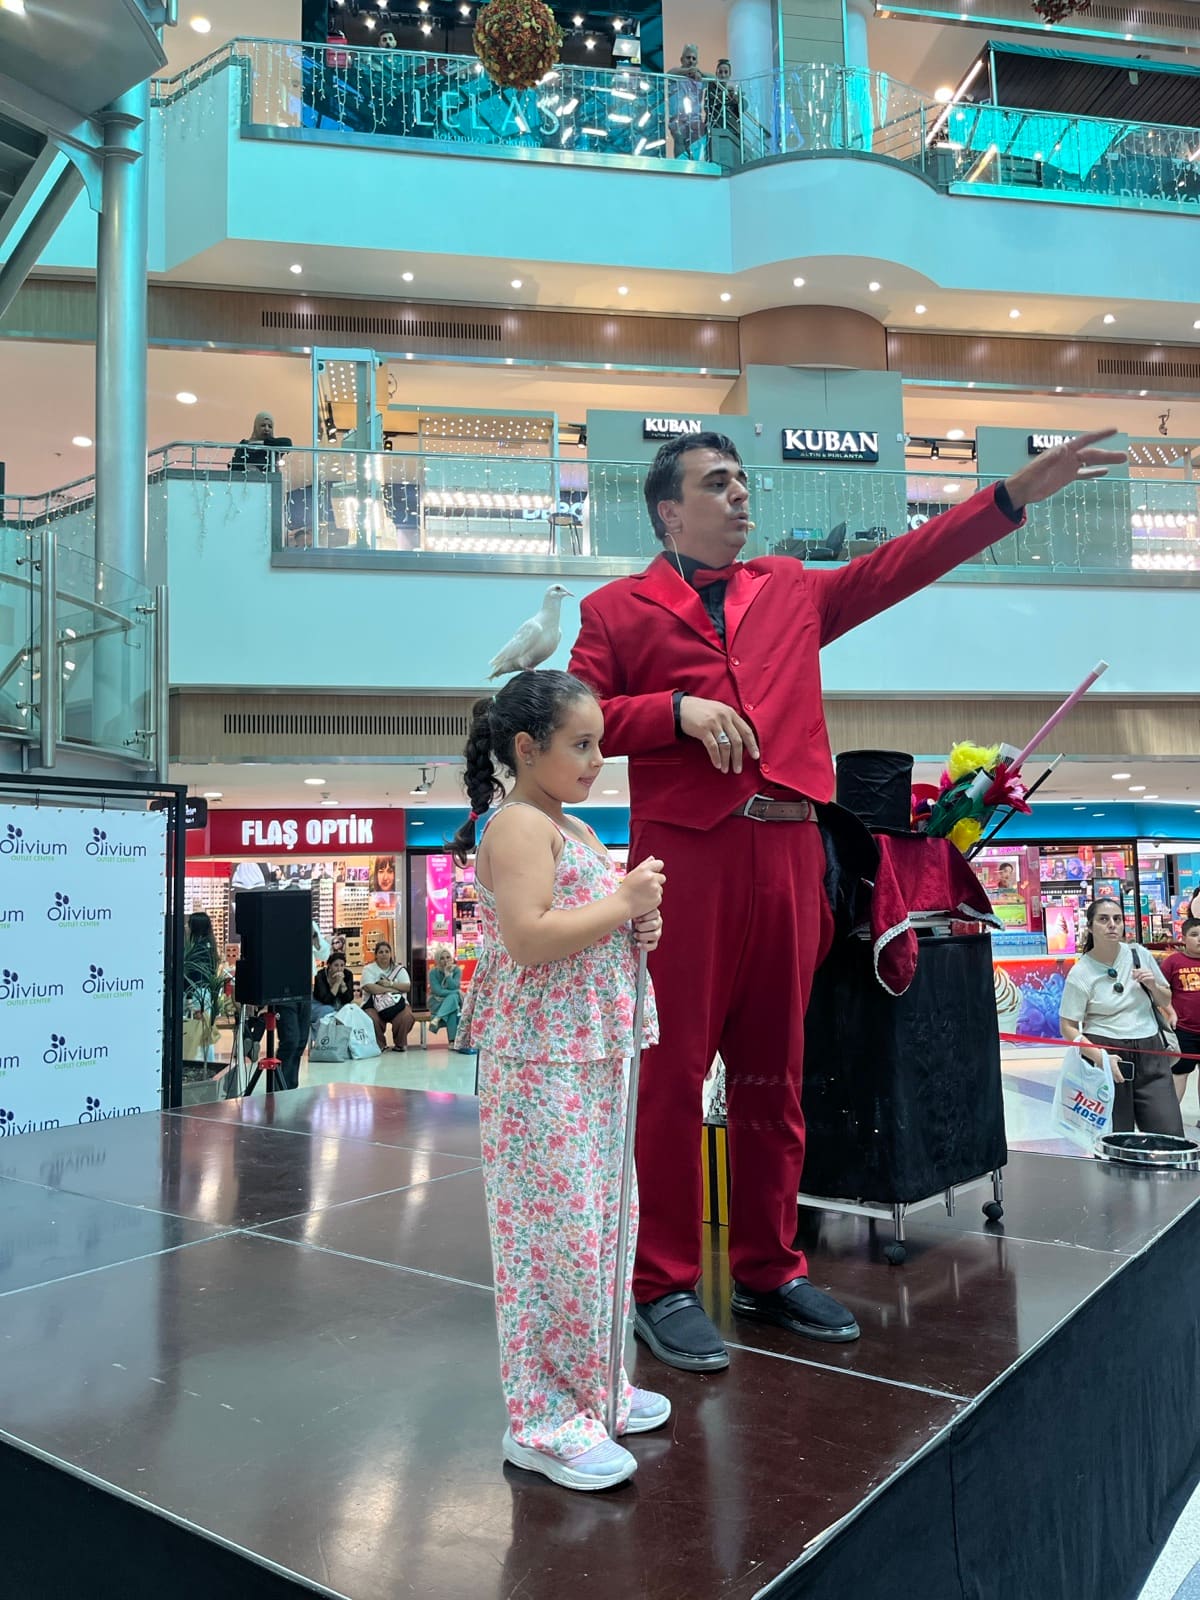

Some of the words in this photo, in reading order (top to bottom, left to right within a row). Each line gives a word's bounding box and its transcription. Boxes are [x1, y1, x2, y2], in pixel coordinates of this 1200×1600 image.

[413, 89, 560, 135] LELAS
[645, 417, 702, 433] KUBAN
[784, 429, 879, 452] KUBAN
[1032, 434, 1077, 448] KUBA
[241, 820, 298, 850] FLAŞ
[305, 814, 374, 845] OPTİK
[0, 839, 67, 855] Olivium
[85, 842, 147, 857] Olivium
[47, 906, 112, 921] Olivium
[0, 982, 64, 999] Olivium
[82, 977, 144, 994] Olivium
[43, 1045, 109, 1064] Olivium
[1072, 1102, 1107, 1127] kasa
